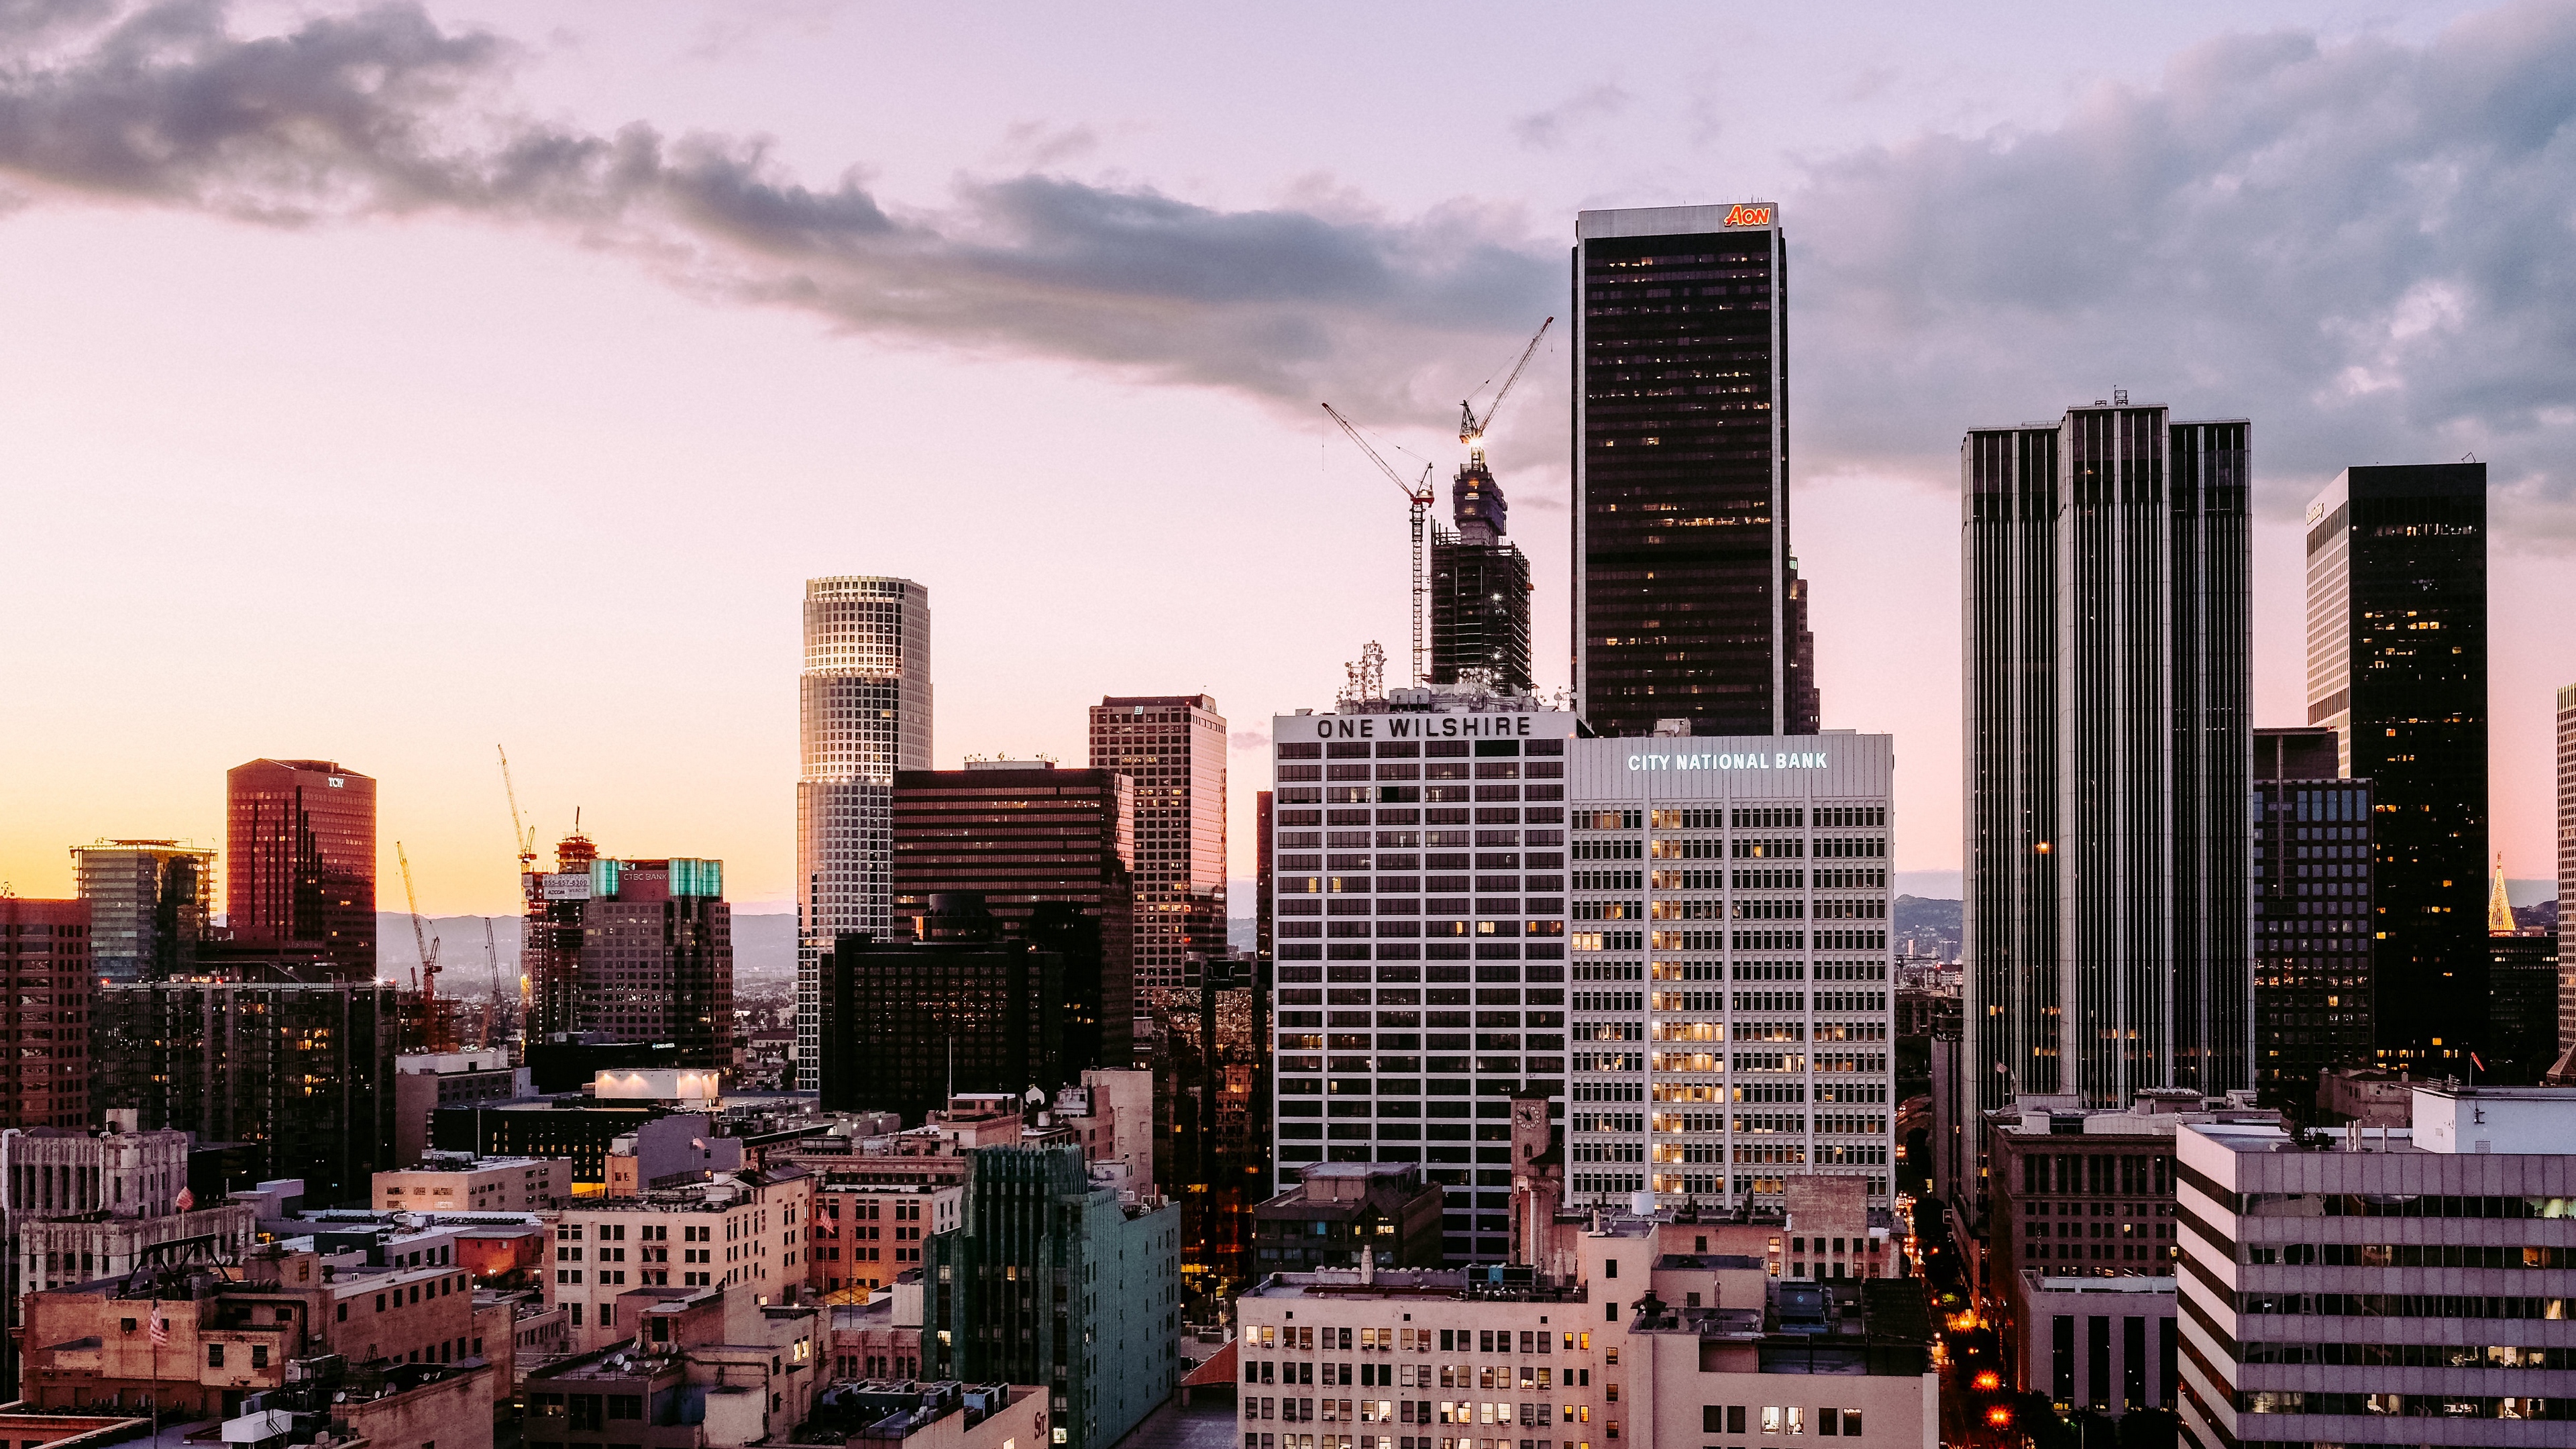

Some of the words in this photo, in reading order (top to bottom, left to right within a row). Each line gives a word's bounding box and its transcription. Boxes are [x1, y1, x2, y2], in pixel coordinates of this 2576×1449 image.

[1318, 719, 1373, 738] ONE
[1389, 716, 1529, 737] WILSHIRE
[1627, 754, 1670, 771] CITY
[1676, 753, 1770, 770] NATIONAL
[1775, 752, 1827, 769] BANK
